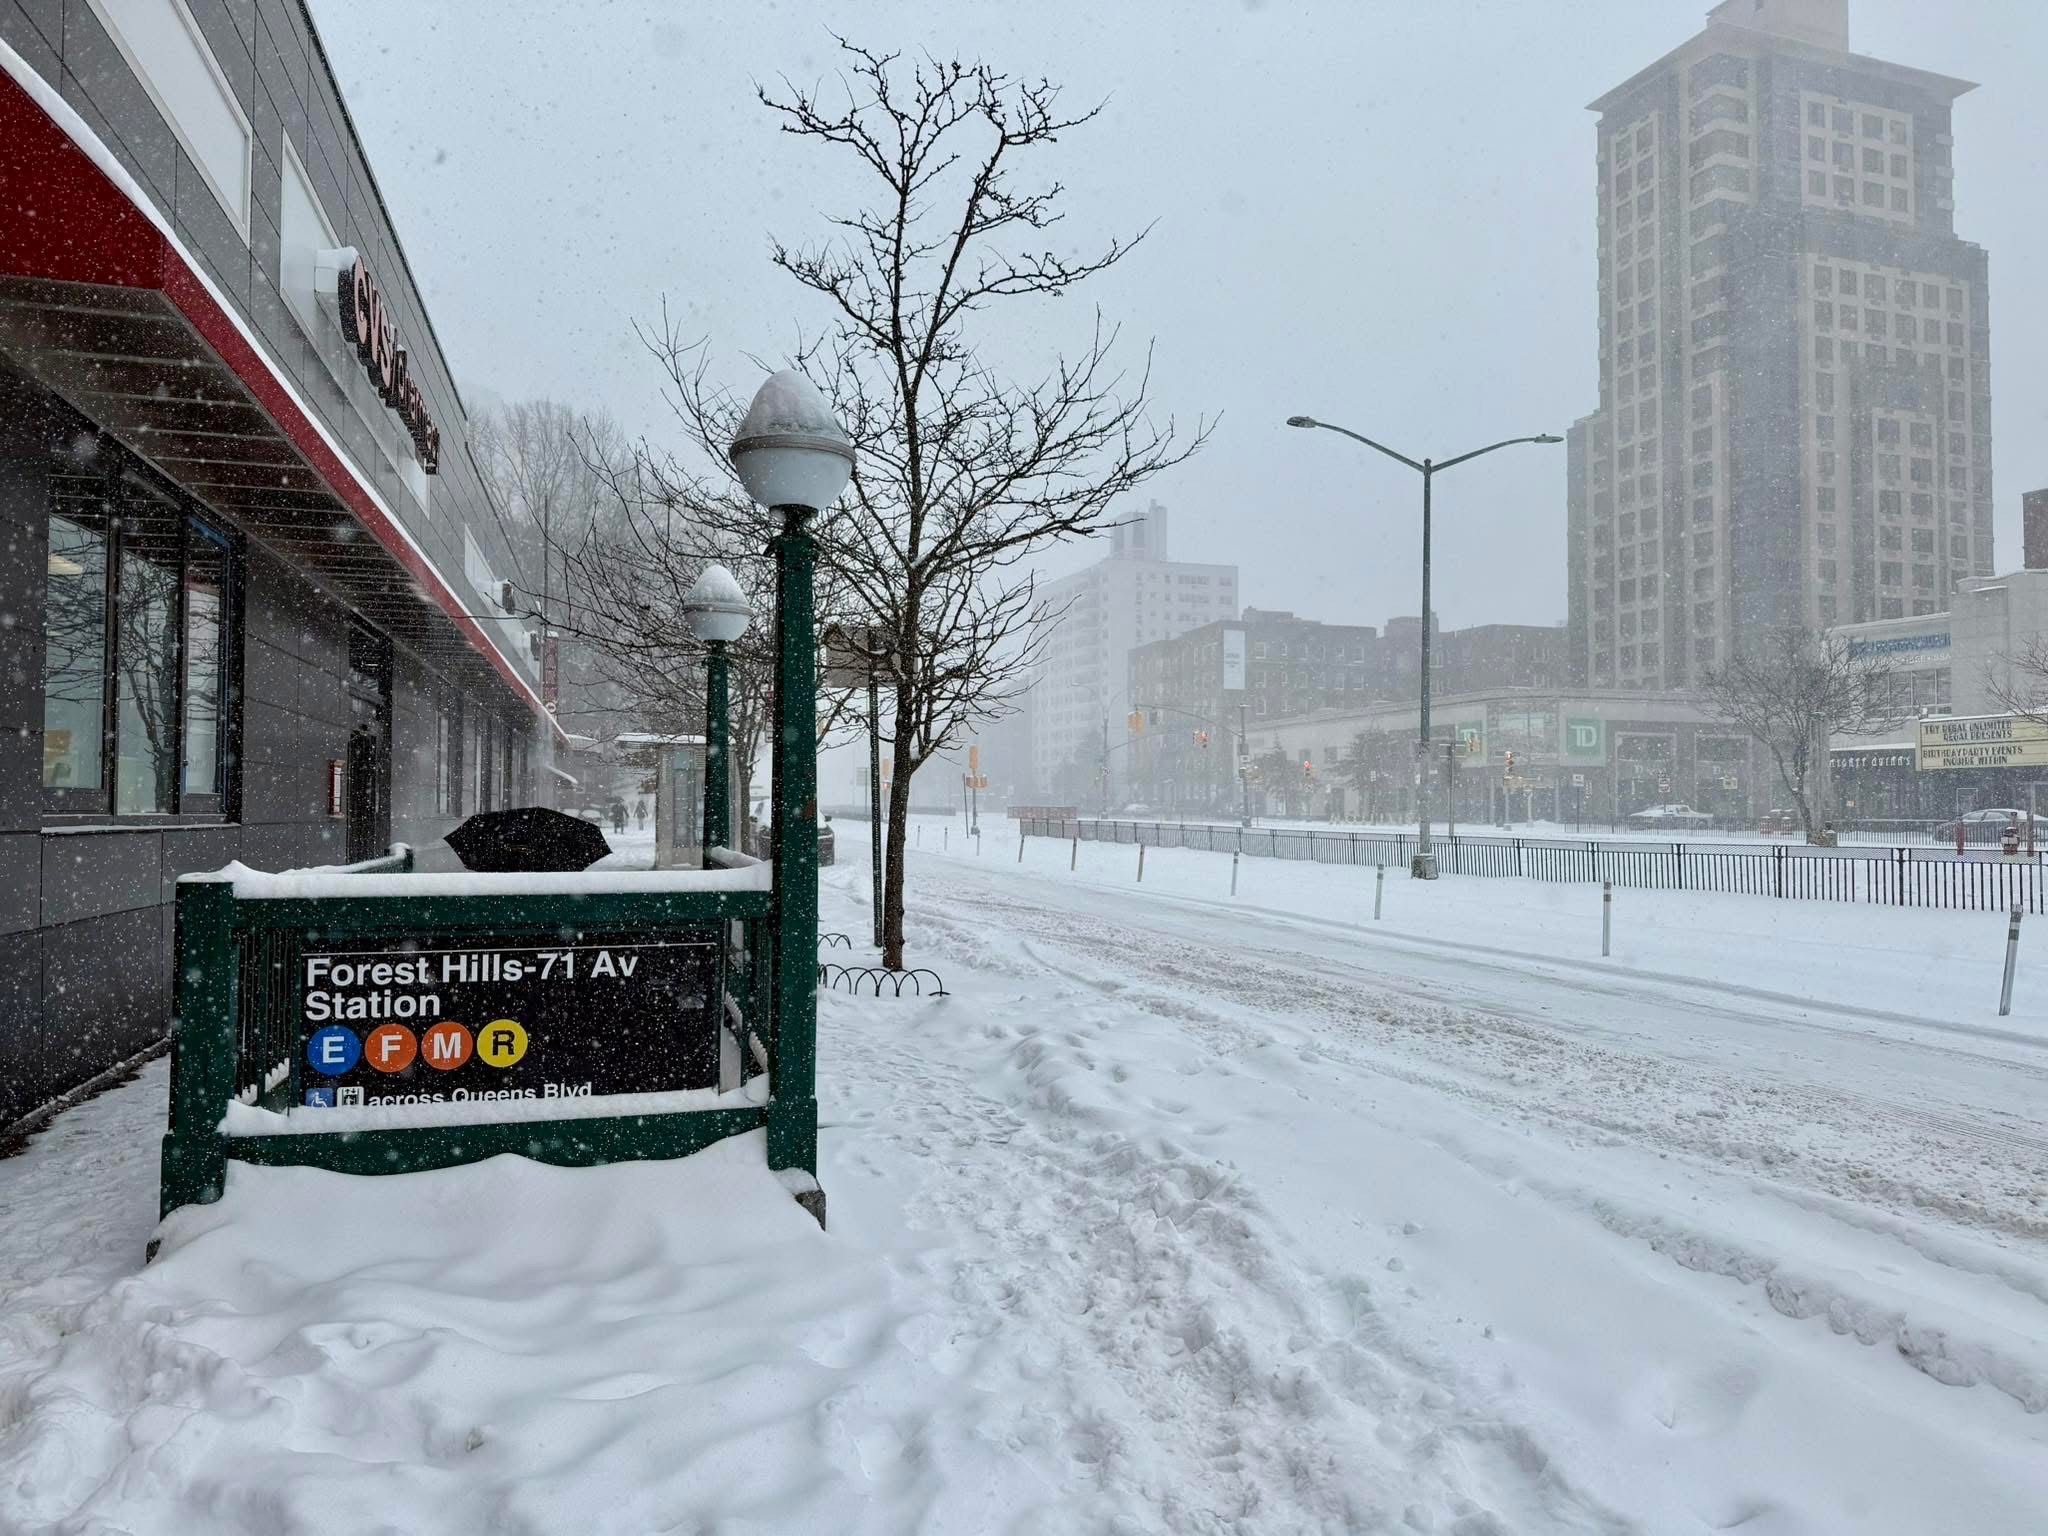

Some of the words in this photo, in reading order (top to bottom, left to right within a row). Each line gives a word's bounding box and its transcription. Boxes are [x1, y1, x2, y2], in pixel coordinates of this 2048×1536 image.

[1569, 725, 1597, 747] TD
[306, 956, 428, 987] Forest
[442, 951, 574, 983] Hills-71
[591, 950, 638, 978] Av
[305, 989, 440, 1021] Station
[321, 1035, 345, 1064] E
[382, 1034, 403, 1062] F
[433, 1032, 462, 1060] M
[491, 1030, 515, 1056] R
[368, 1093, 444, 1107] across
[452, 1087, 537, 1102] Queens
[544, 1082, 592, 1099] Blvd
